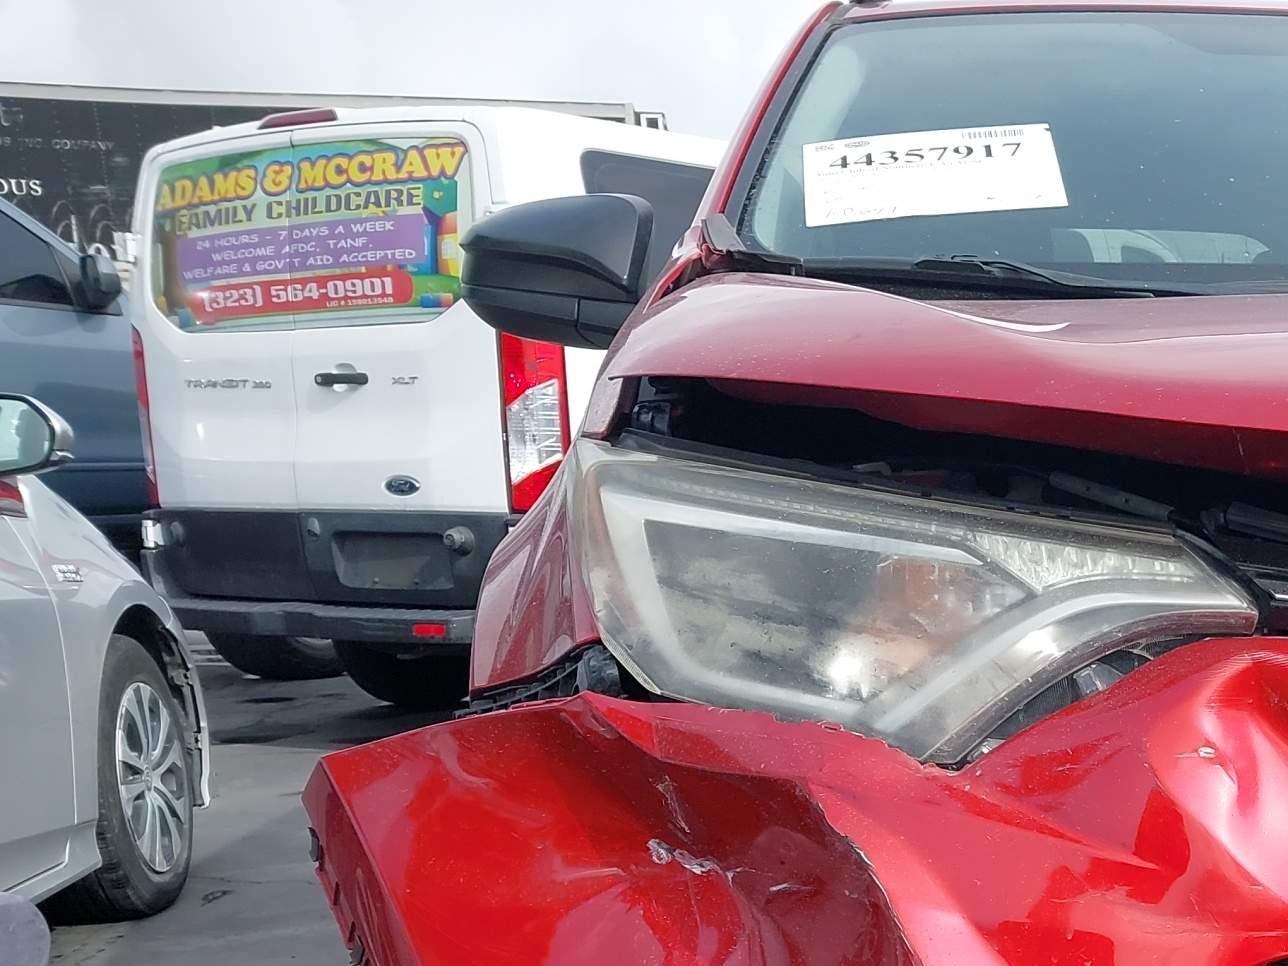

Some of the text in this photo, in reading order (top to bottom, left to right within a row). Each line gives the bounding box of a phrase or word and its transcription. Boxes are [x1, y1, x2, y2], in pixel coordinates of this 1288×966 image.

[828, 142, 1022, 169] 44357917
[156, 144, 466, 210] ADAMS & MCCRAW
[177, 186, 422, 233] FAMILY CHILDCARE
[196, 239, 211, 251] 24
[214, 233, 259, 248] HOURS
[278, 230, 288, 241] 7
[292, 226, 329, 240] DAYS
[334, 225, 345, 234] A
[350, 220, 395, 234] WEEK
[183, 248, 417, 280] WELFARE & GOV'T AID ACCEPTED
[212, 244, 276, 262] WELCOME
[203, 284, 263, 312] (323)
[270, 277, 393, 303] 564-0901
[391, 375, 419, 385] XLT
